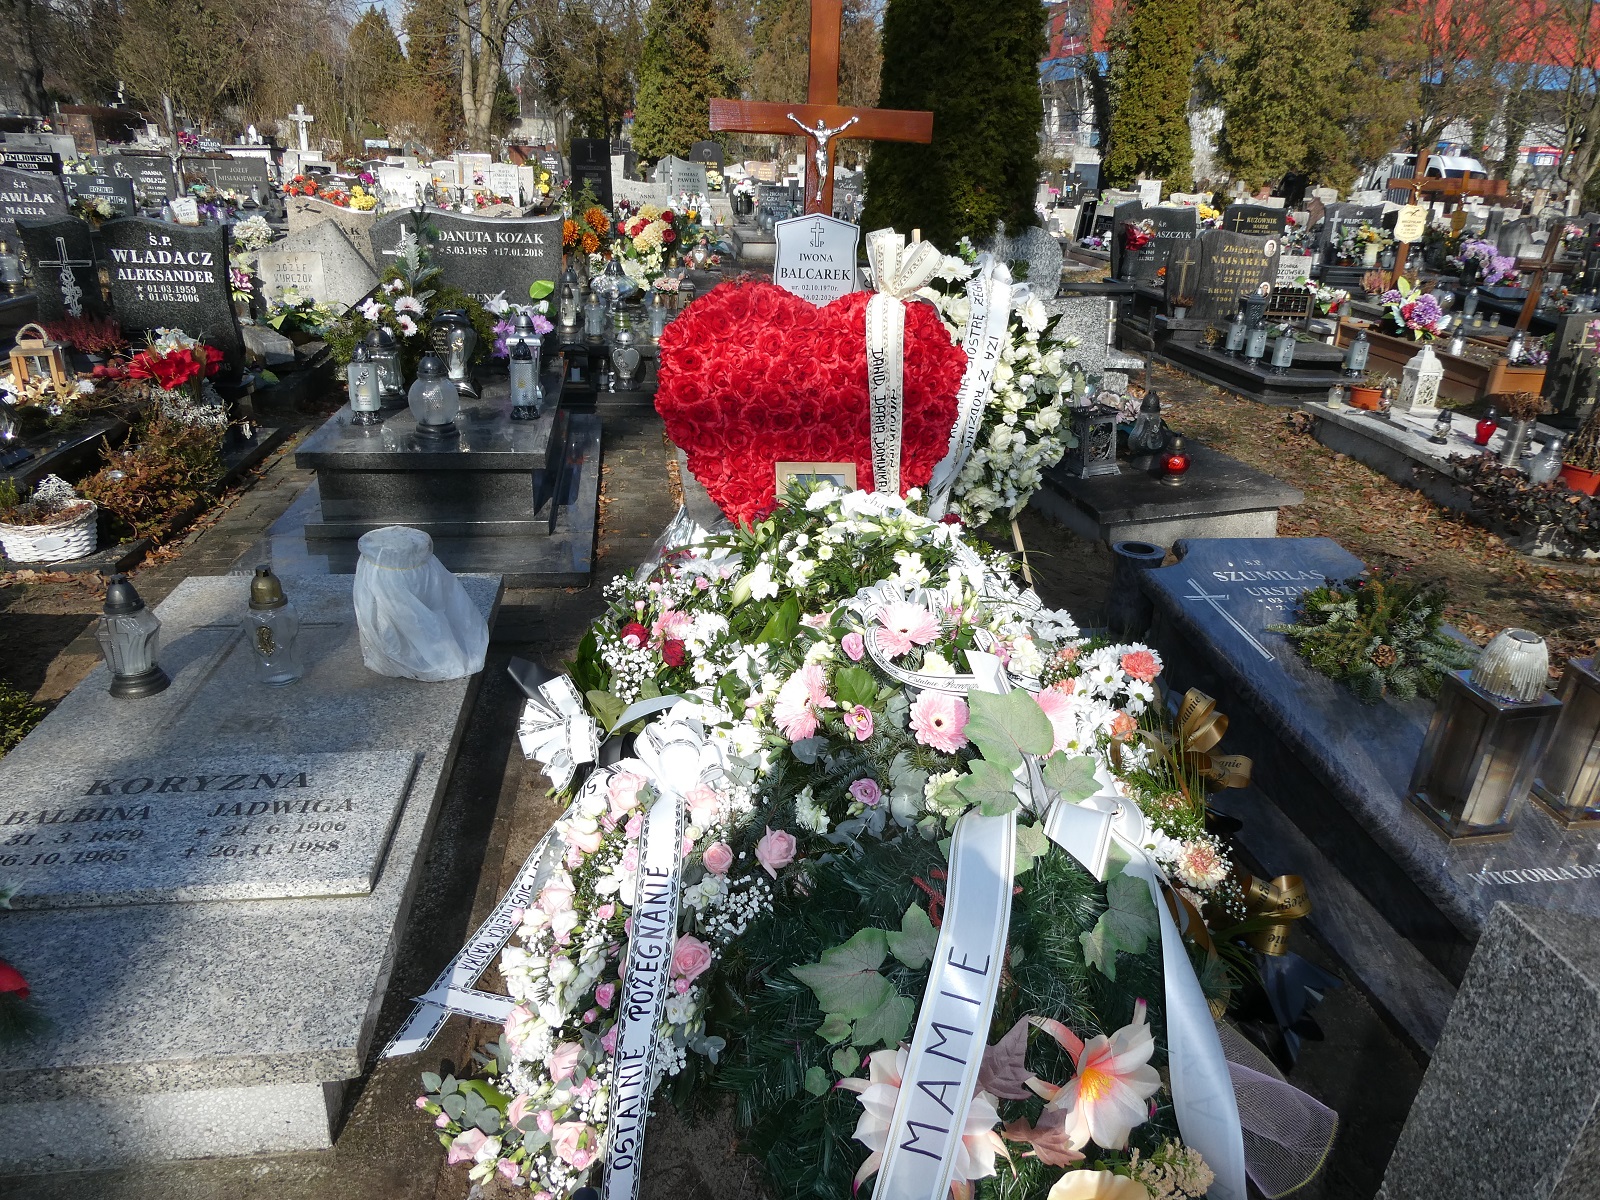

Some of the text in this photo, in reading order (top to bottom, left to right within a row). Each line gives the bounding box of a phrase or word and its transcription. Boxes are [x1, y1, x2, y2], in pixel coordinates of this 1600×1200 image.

[5, 206, 46, 216] MARIA
[439, 230, 544, 244] DANUTA KOZAK
[110, 248, 214, 266] WLADACZ
[799, 253, 834, 263] IWONA
[118, 268, 215, 283] ALEKSANDER
[780, 267, 851, 281] BALCAREK
[984, 336, 999, 360] IZA
[1212, 569, 1327, 582] SZUMILAS
[82, 771, 311, 796] KORYZNA
[0, 798, 354, 826] BALBINA JADWIGA
[1467, 865, 1579, 886] WIKTORIA
[900, 945, 991, 1161] MAMIE
[612, 1045, 647, 1171] OSTATNIE
